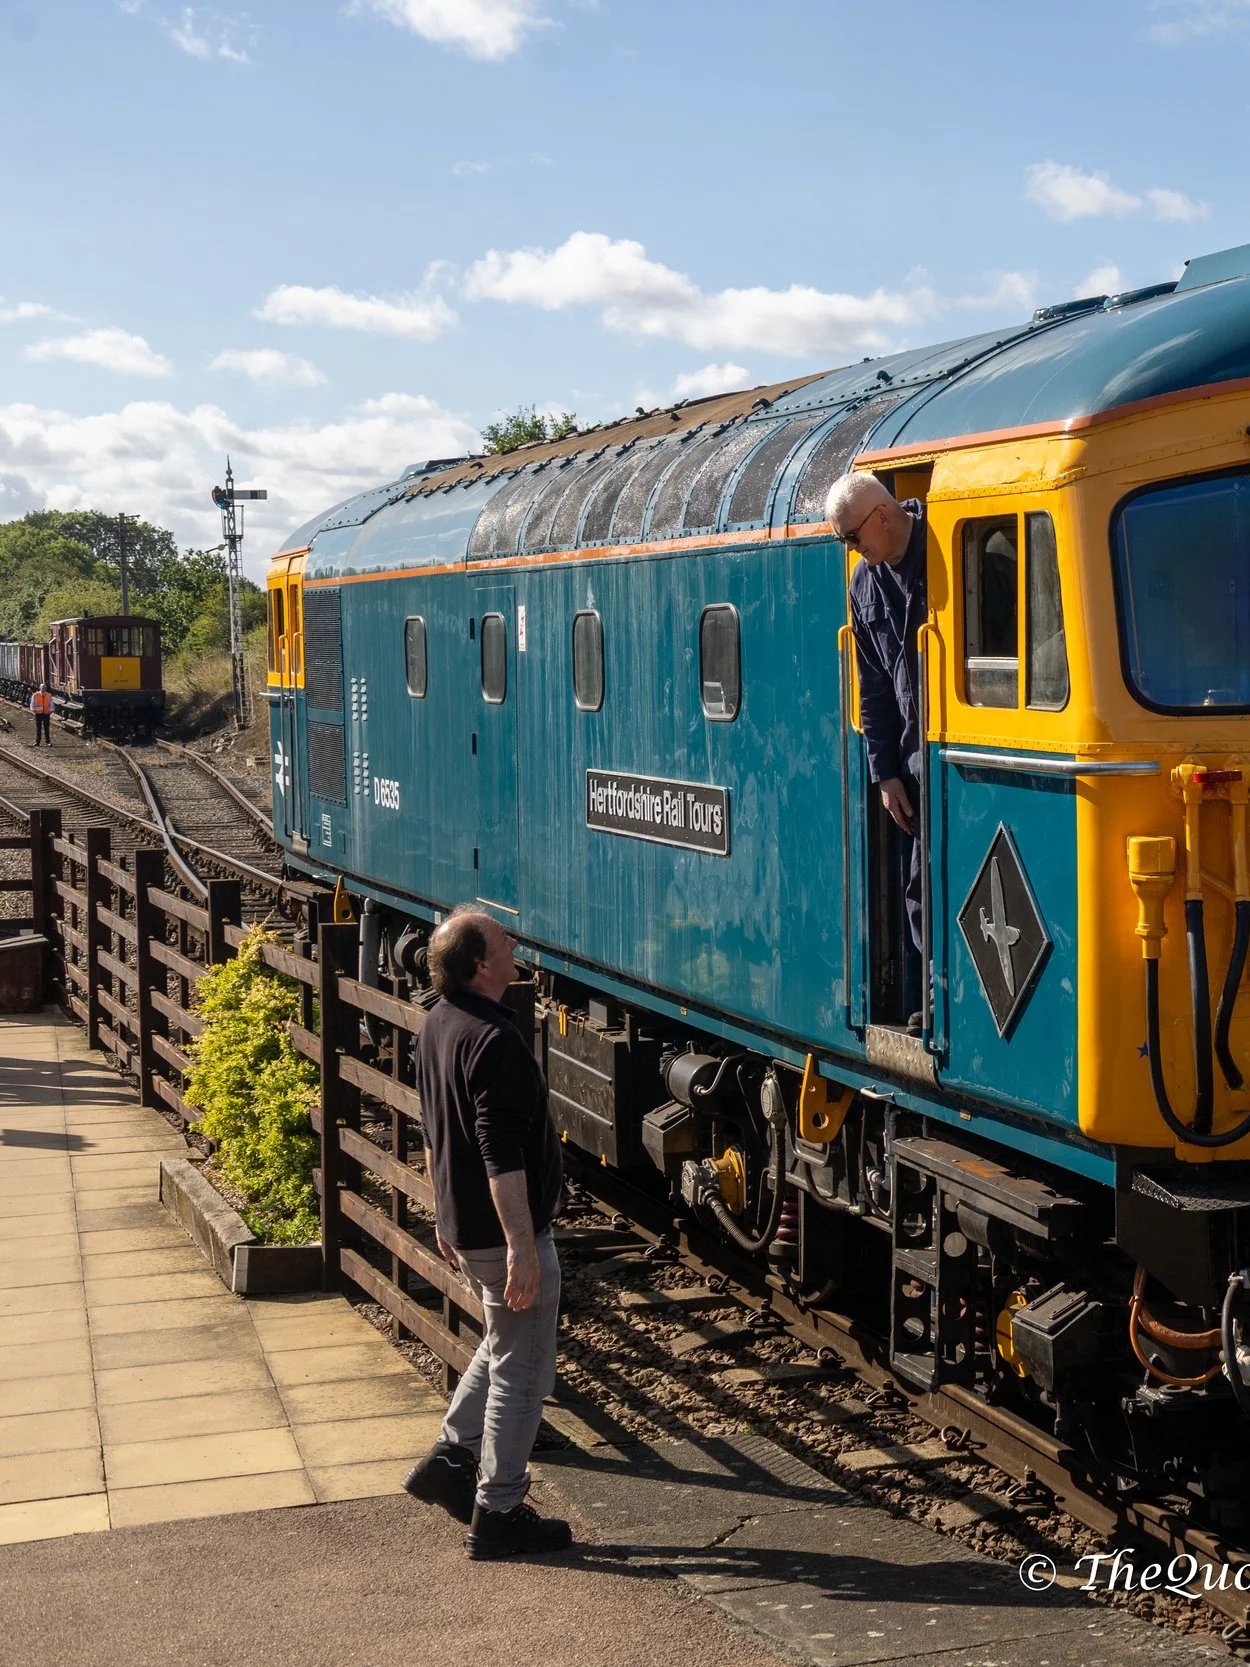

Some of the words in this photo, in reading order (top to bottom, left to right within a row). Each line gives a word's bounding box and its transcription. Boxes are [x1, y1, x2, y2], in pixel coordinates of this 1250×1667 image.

[589, 779, 662, 824] Hertfordshire
[663, 790, 685, 828] Rail
[687, 793, 723, 835] Tours
